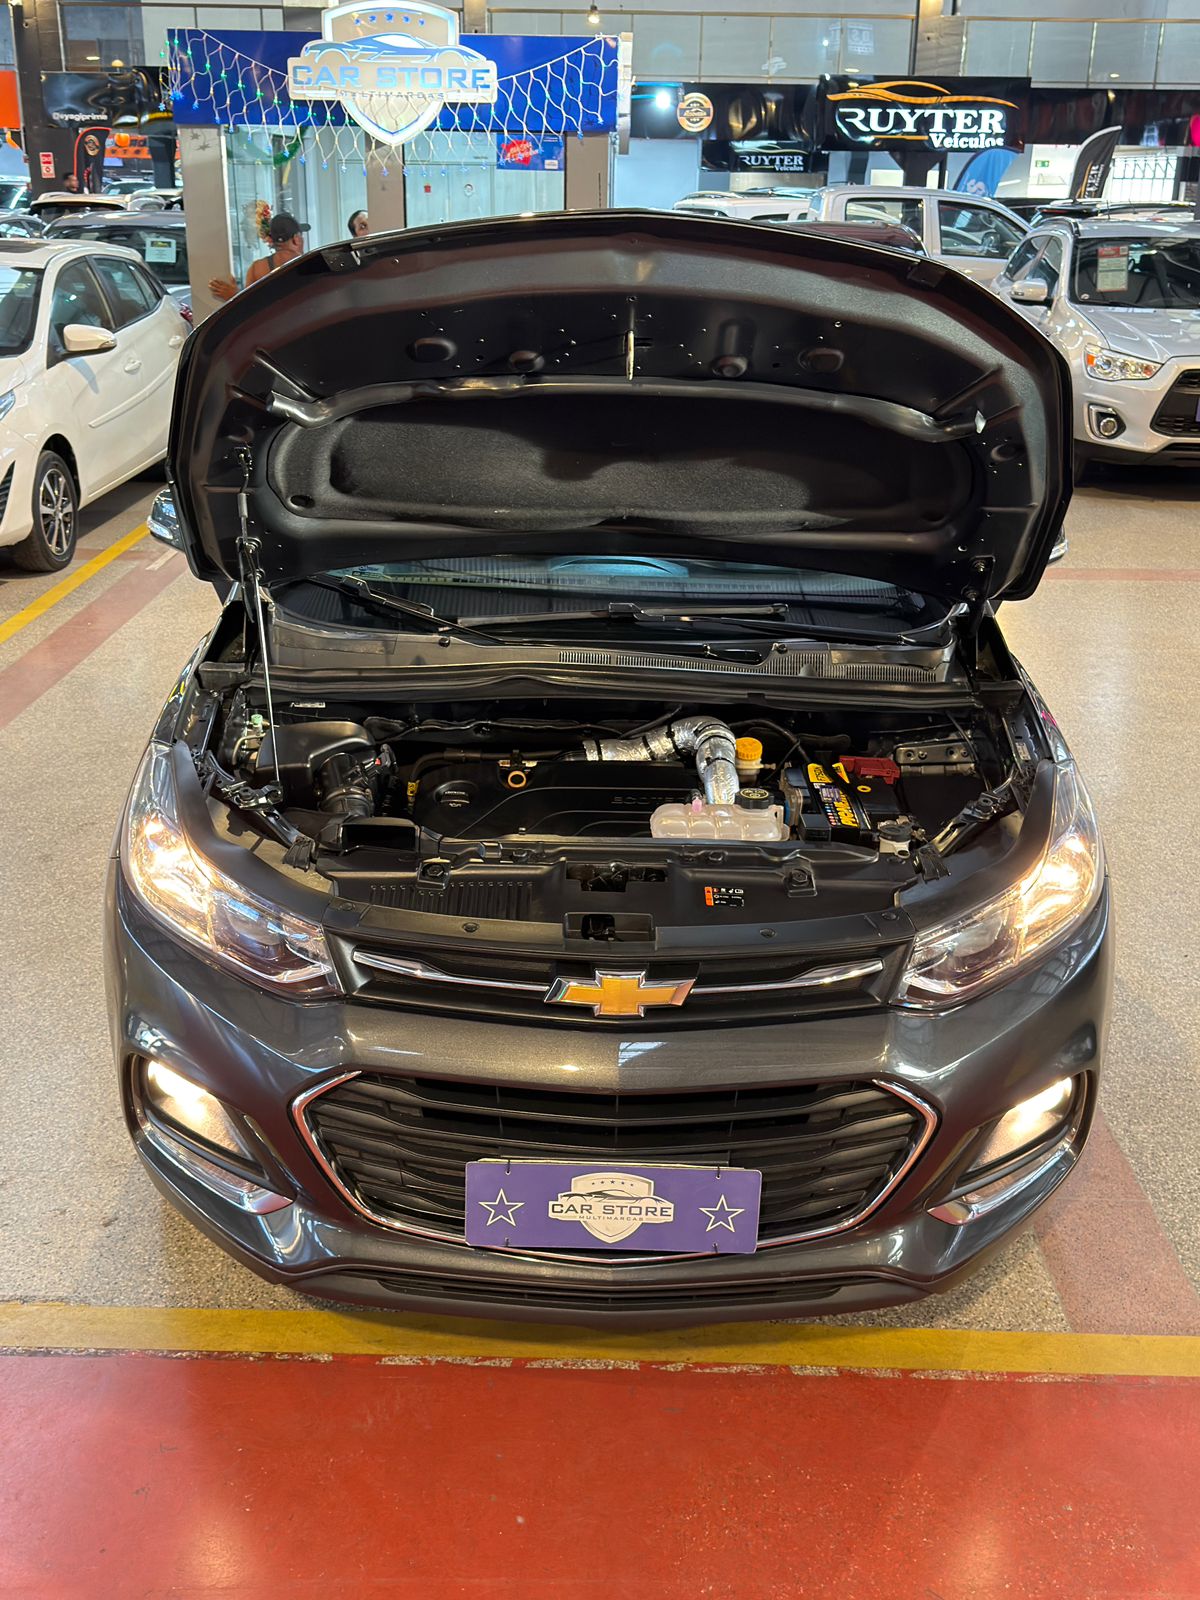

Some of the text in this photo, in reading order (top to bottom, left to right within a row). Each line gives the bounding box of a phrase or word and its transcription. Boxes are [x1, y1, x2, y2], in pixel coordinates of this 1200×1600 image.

[292, 65, 491, 90] CAR STORE
[838, 107, 1006, 134] RUYTER
[739, 155, 804, 166] RUYTER
[551, 1203, 672, 1217] CAR STORE
